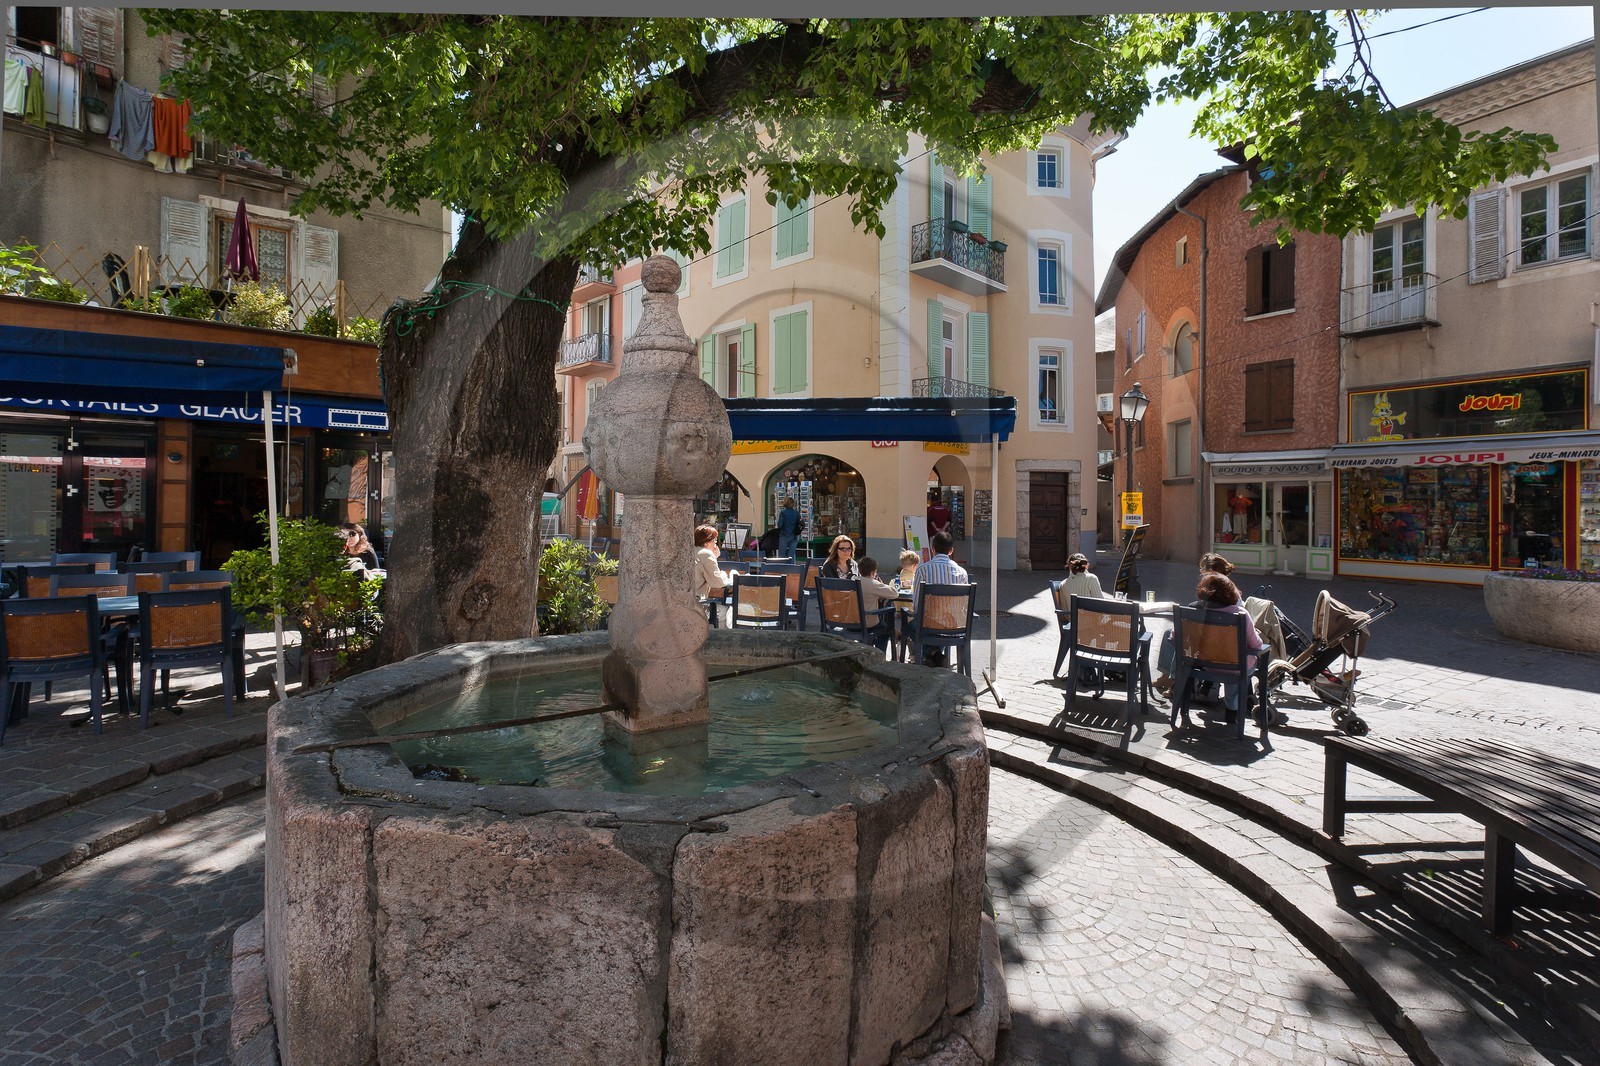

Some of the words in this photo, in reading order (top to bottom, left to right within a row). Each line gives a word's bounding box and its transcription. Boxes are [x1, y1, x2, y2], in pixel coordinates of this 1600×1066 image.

[1459, 393, 1522, 412] JOUPI
[1414, 452, 1504, 465] JOUPI
[1528, 450, 1600, 460] JEUX-MINIATU
[1331, 459, 1367, 467] BERTRAND
[1217, 466, 1264, 474] BOUTIQUE
[1268, 465, 1311, 473] ENFANTS
[1515, 464, 1549, 473] JOUPI
